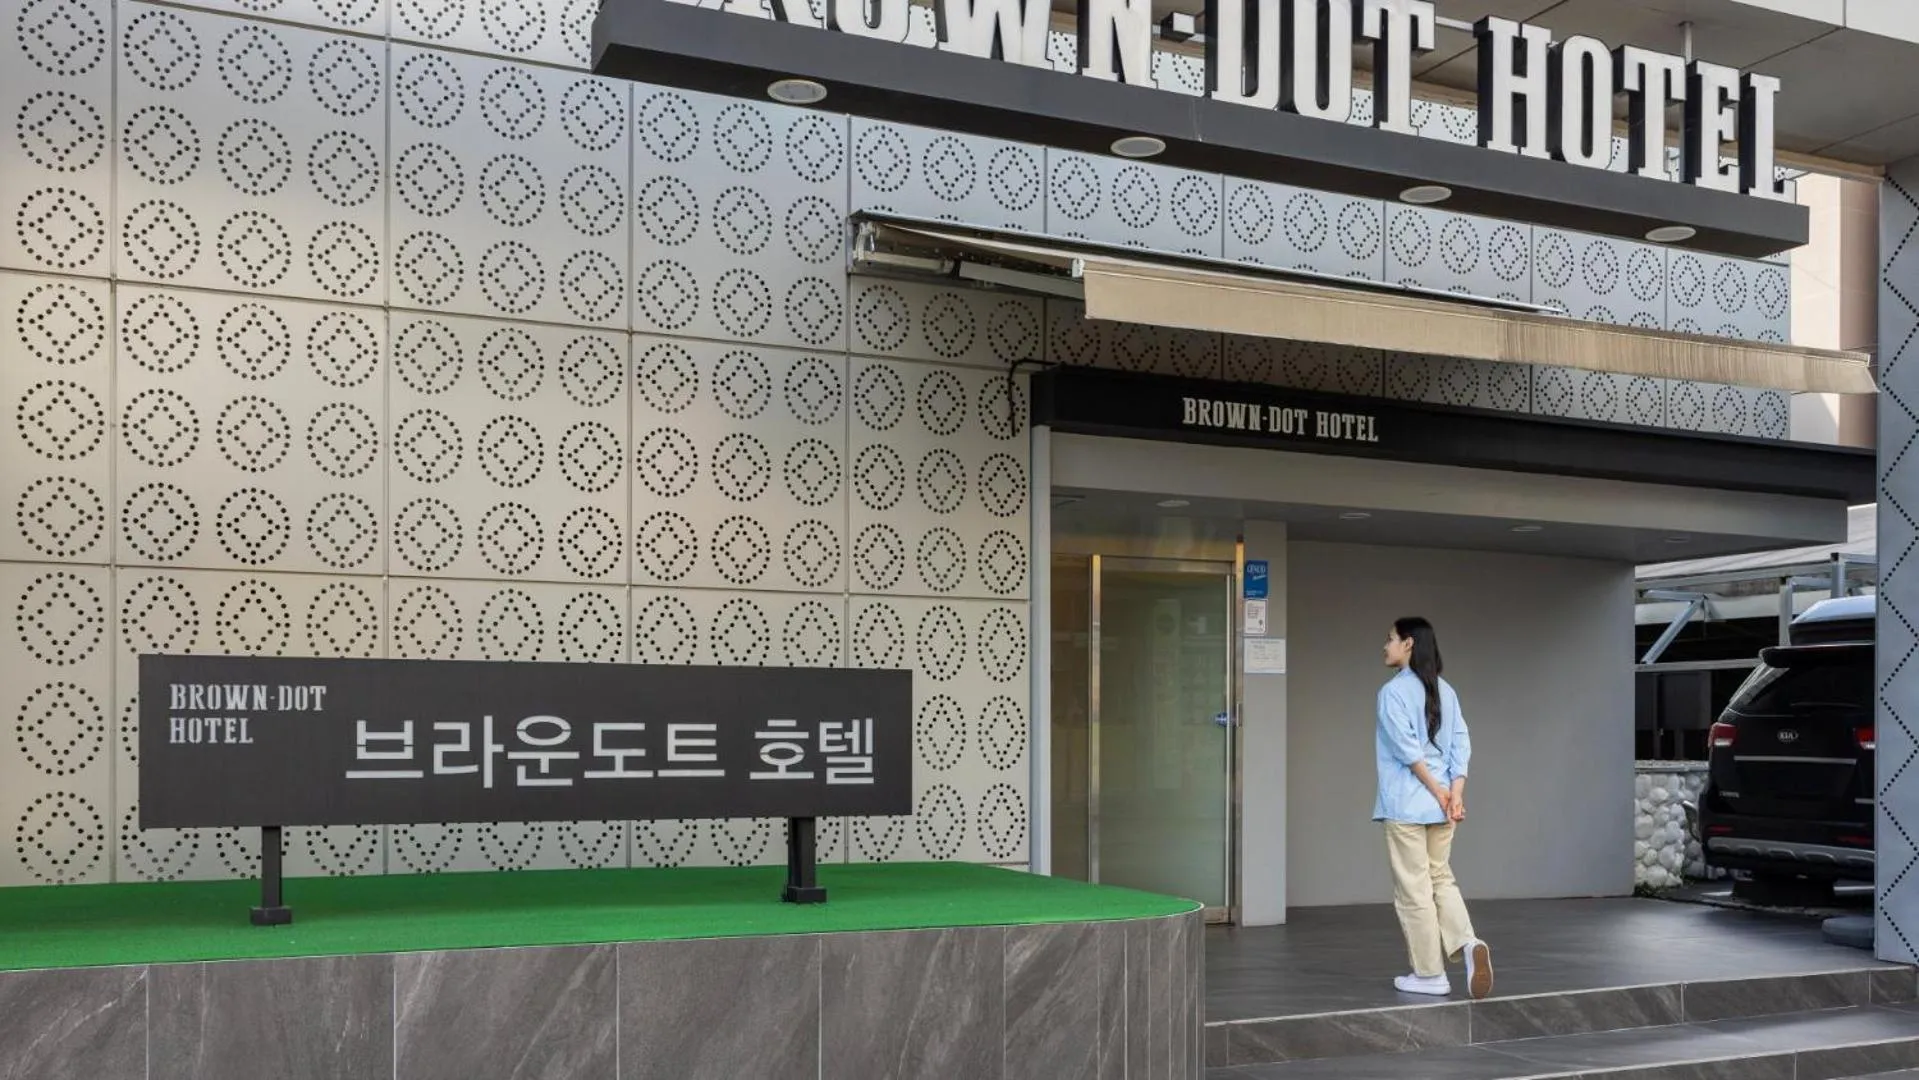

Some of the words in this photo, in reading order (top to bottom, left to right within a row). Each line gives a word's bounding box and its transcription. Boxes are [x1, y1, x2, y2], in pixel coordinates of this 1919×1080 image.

[1484, 14, 1797, 203] HOTEL
[1316, 411, 1379, 442] HOTEL
[169, 717, 254, 744] HOTEL
[345, 715, 726, 789] 브라운도트
[749, 717, 875, 785] 호텔
